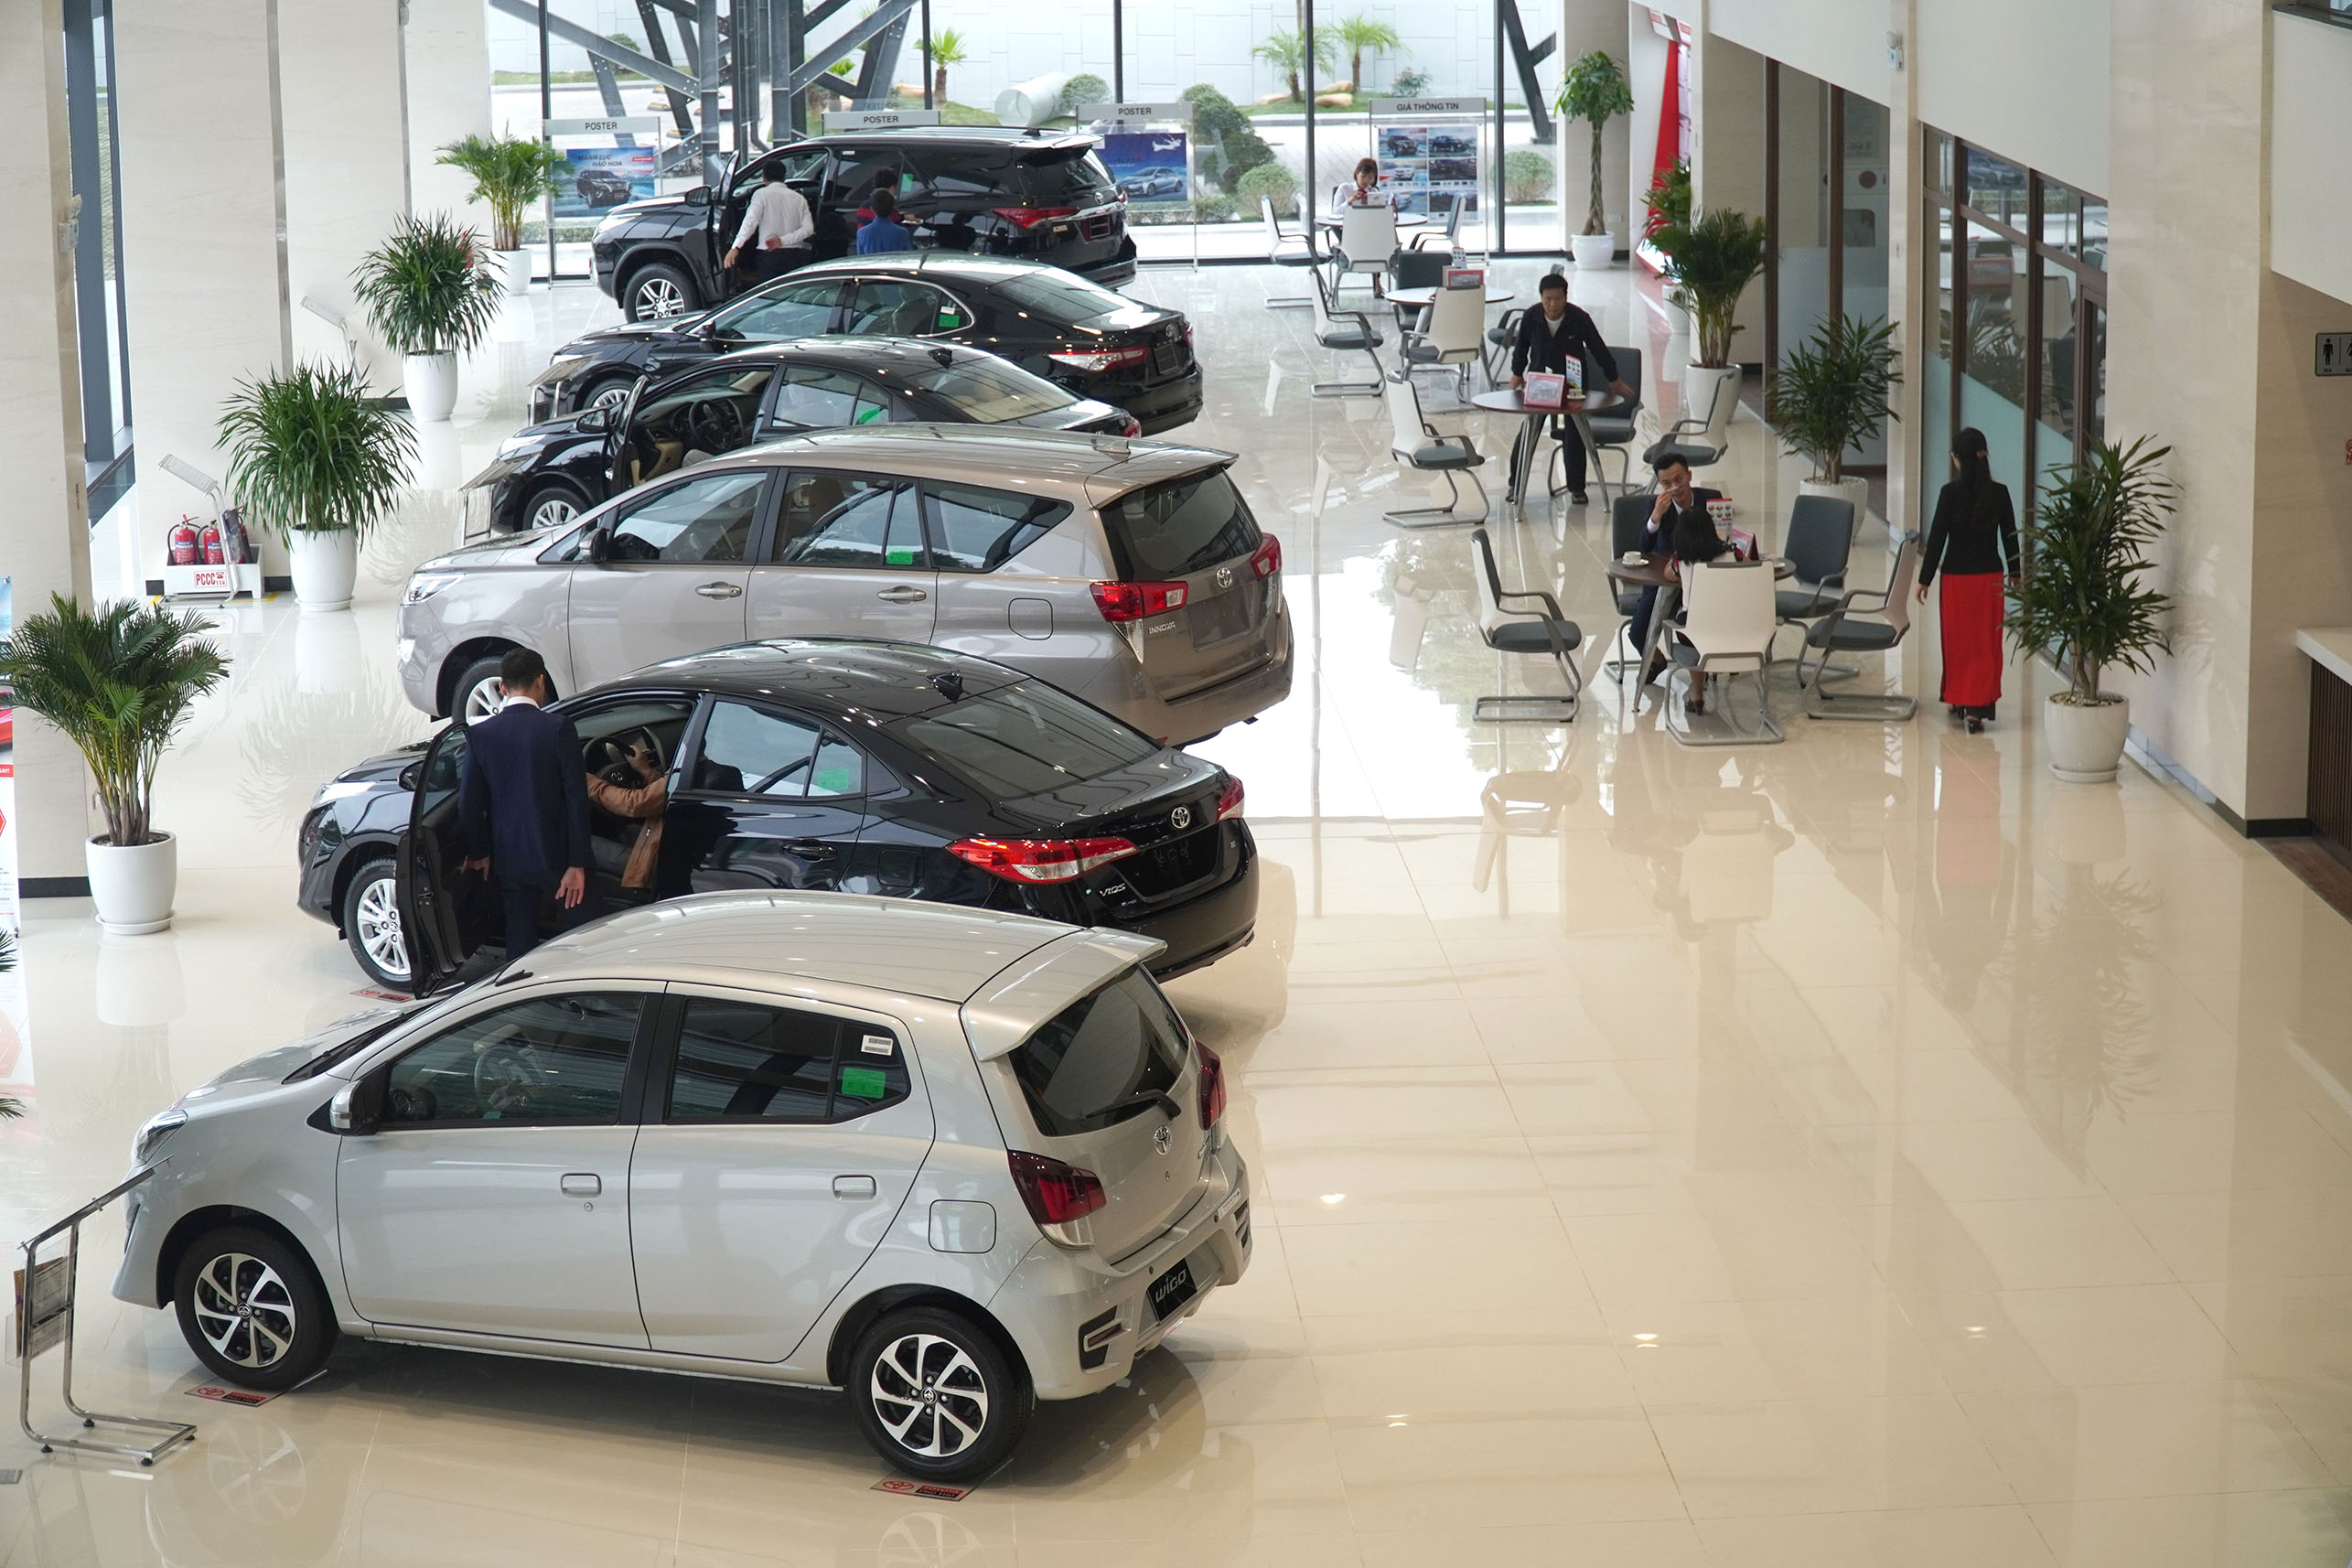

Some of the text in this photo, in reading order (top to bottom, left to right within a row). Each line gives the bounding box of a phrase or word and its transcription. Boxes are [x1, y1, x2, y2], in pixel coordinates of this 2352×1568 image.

[1118, 107, 1152, 115] POSTER
[1396, 102, 1412, 111] GIÁ
[1413, 102, 1444, 111] THÔNG
[864, 115, 899, 124] POSTER
[585, 122, 618, 130] POSTER
[196, 573, 216, 586] PCCC
[1149, 621, 1176, 635] INNOVA
[1100, 883, 1126, 897] VIOS
